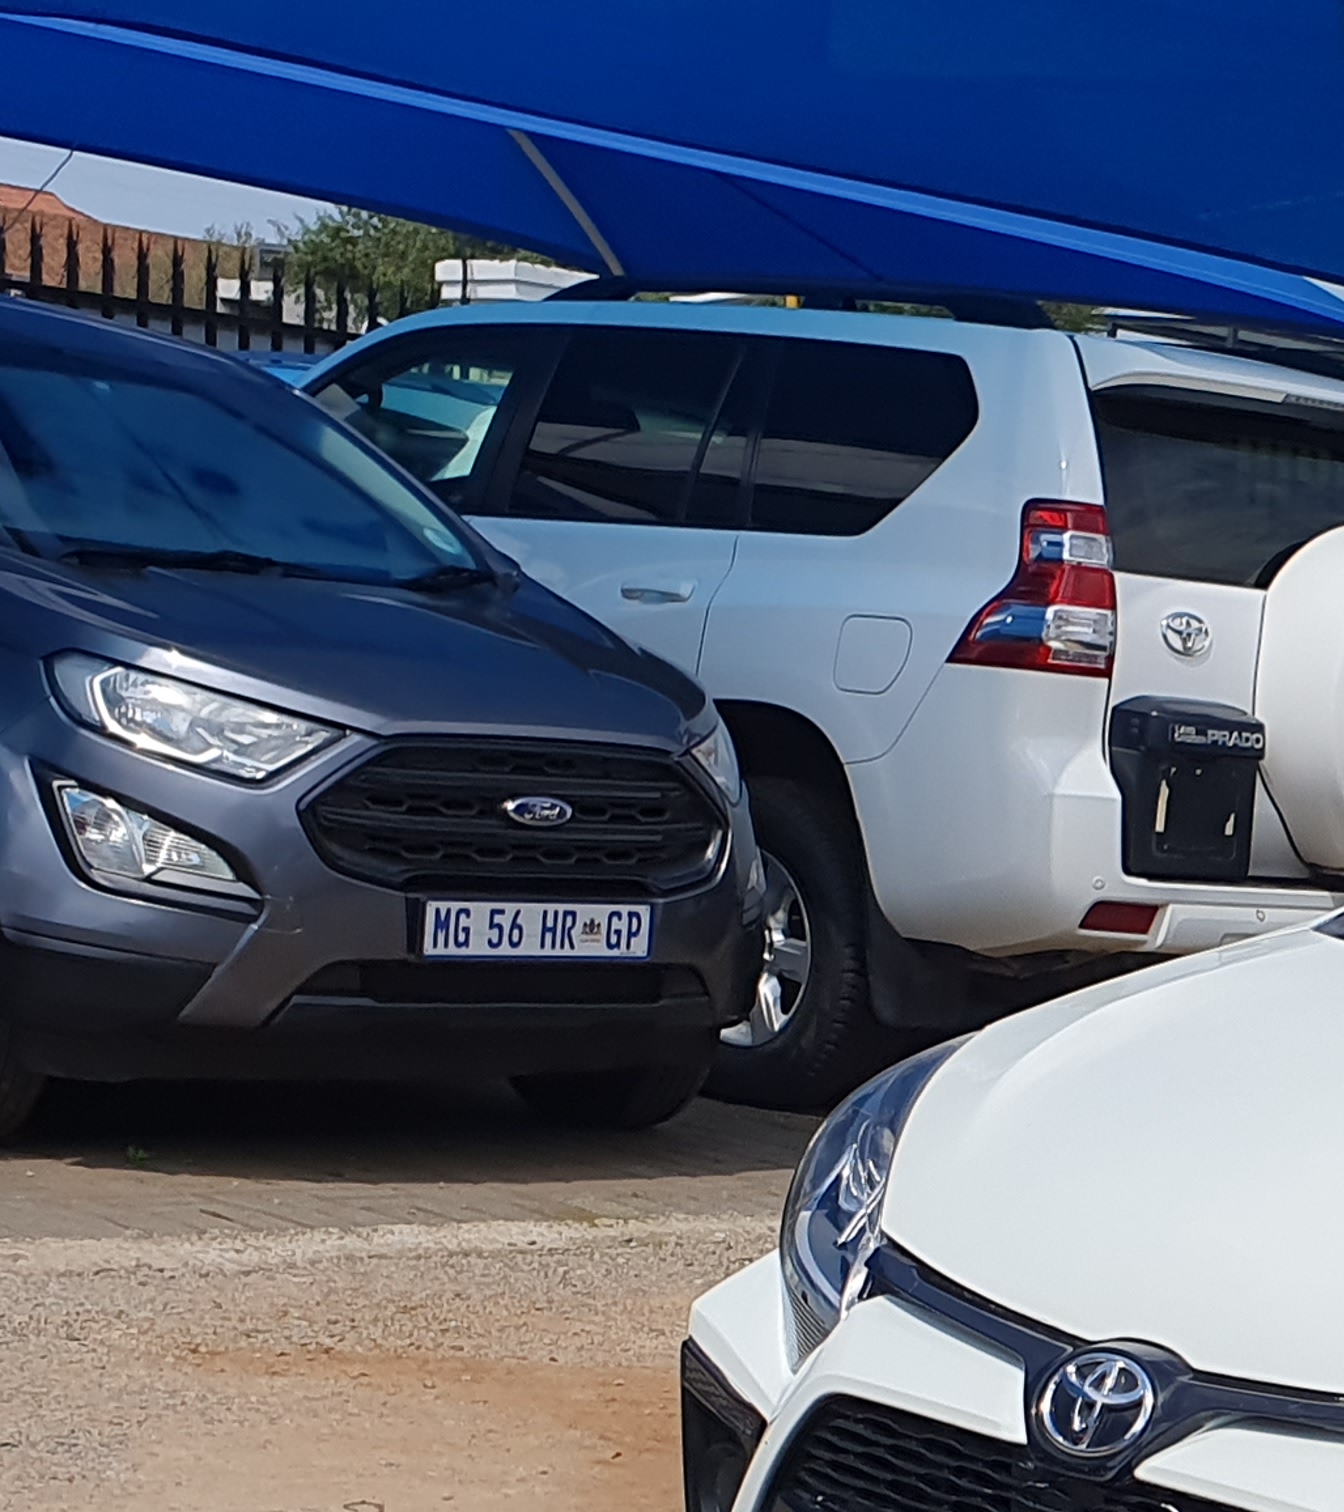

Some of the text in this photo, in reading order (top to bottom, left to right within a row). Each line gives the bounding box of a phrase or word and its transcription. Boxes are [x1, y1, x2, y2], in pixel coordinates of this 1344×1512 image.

[1206, 729, 1264, 749] PRADO
[432, 907, 642, 951] MG 56 HR GP
